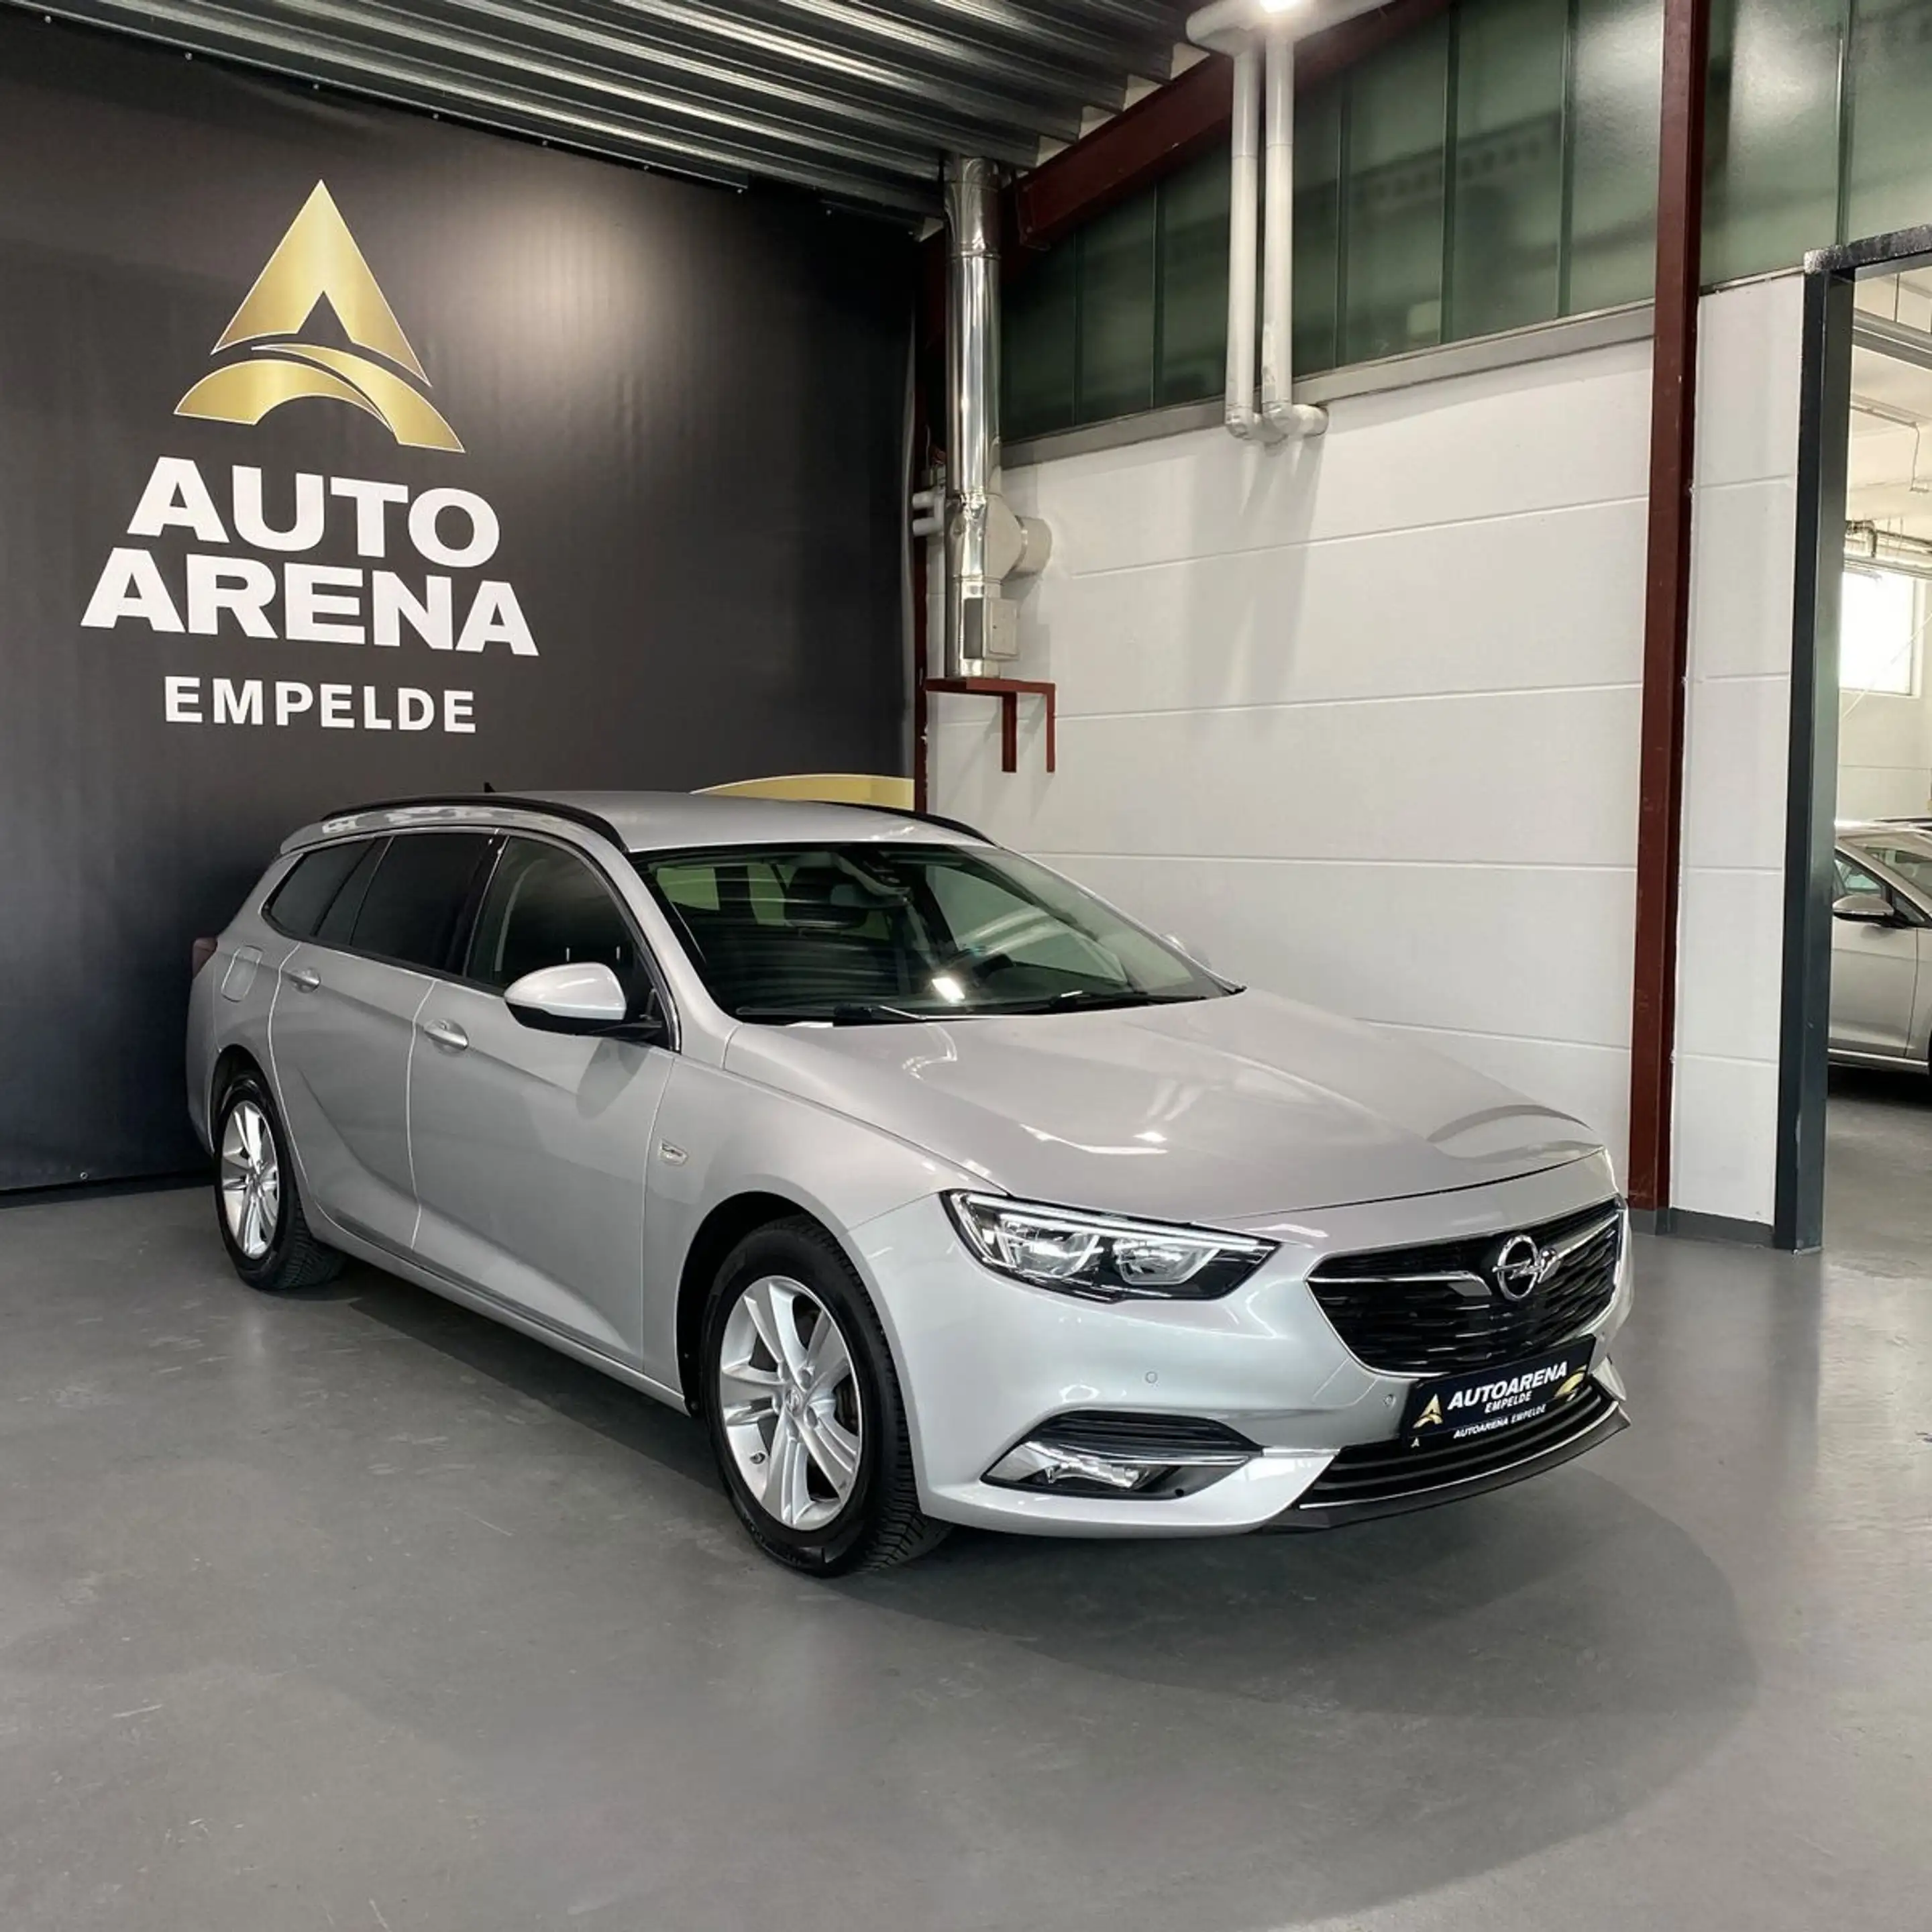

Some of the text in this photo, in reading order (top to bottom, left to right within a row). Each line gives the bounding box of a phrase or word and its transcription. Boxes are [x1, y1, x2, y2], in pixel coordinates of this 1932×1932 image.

[126, 456, 501, 568] AUTO
[80, 547, 539, 657] ARENA
[164, 675, 477, 733] EMPELDE
[1447, 1361, 1568, 1410] AUTOARENA
[1485, 1391, 1532, 1413] EMPELDE
[1453, 1417, 1508, 1439] AUTOARENA
